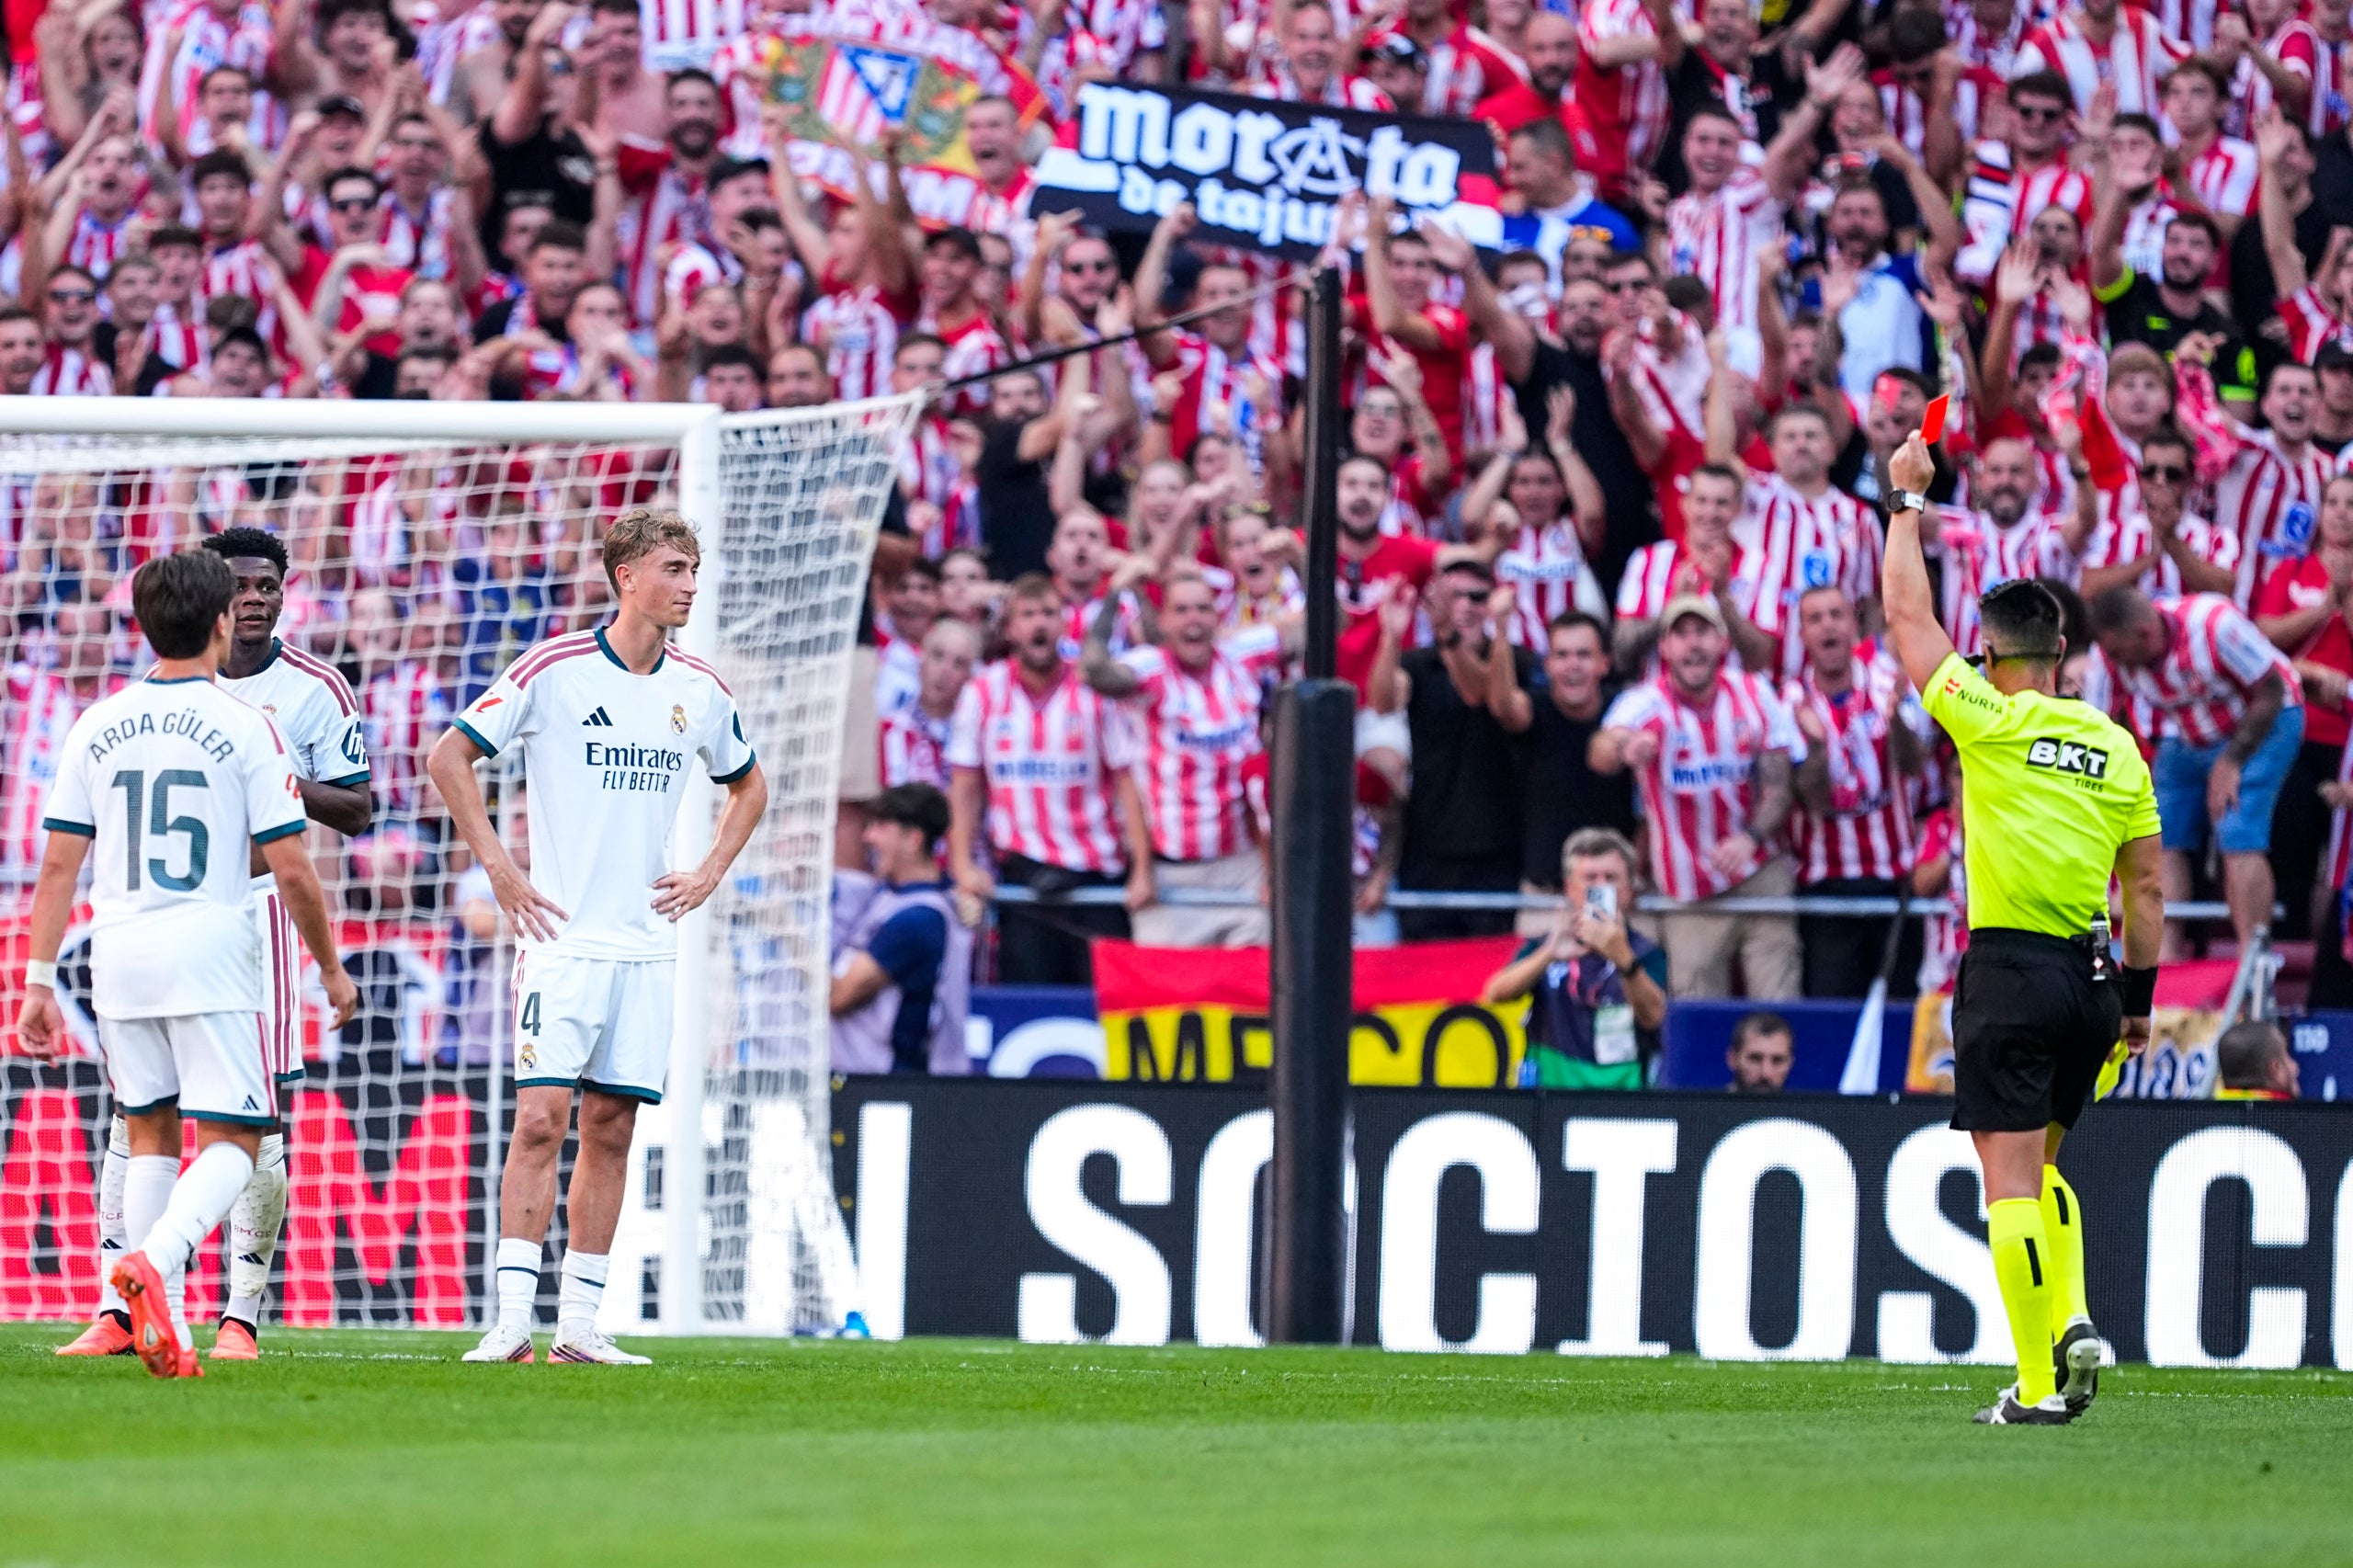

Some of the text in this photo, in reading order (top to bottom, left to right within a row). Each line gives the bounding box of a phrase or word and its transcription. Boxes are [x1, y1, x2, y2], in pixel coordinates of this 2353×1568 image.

[1119, 164, 1411, 254] de taju
[89, 708, 234, 765] ARDA GÜLER
[585, 742, 683, 771] Emirates
[2027, 737, 2109, 778] BKT
[602, 770, 670, 793] FLY BETTR
[2075, 778, 2104, 792] TIRES
[111, 769, 210, 892] 15
[521, 992, 541, 1037] 4
